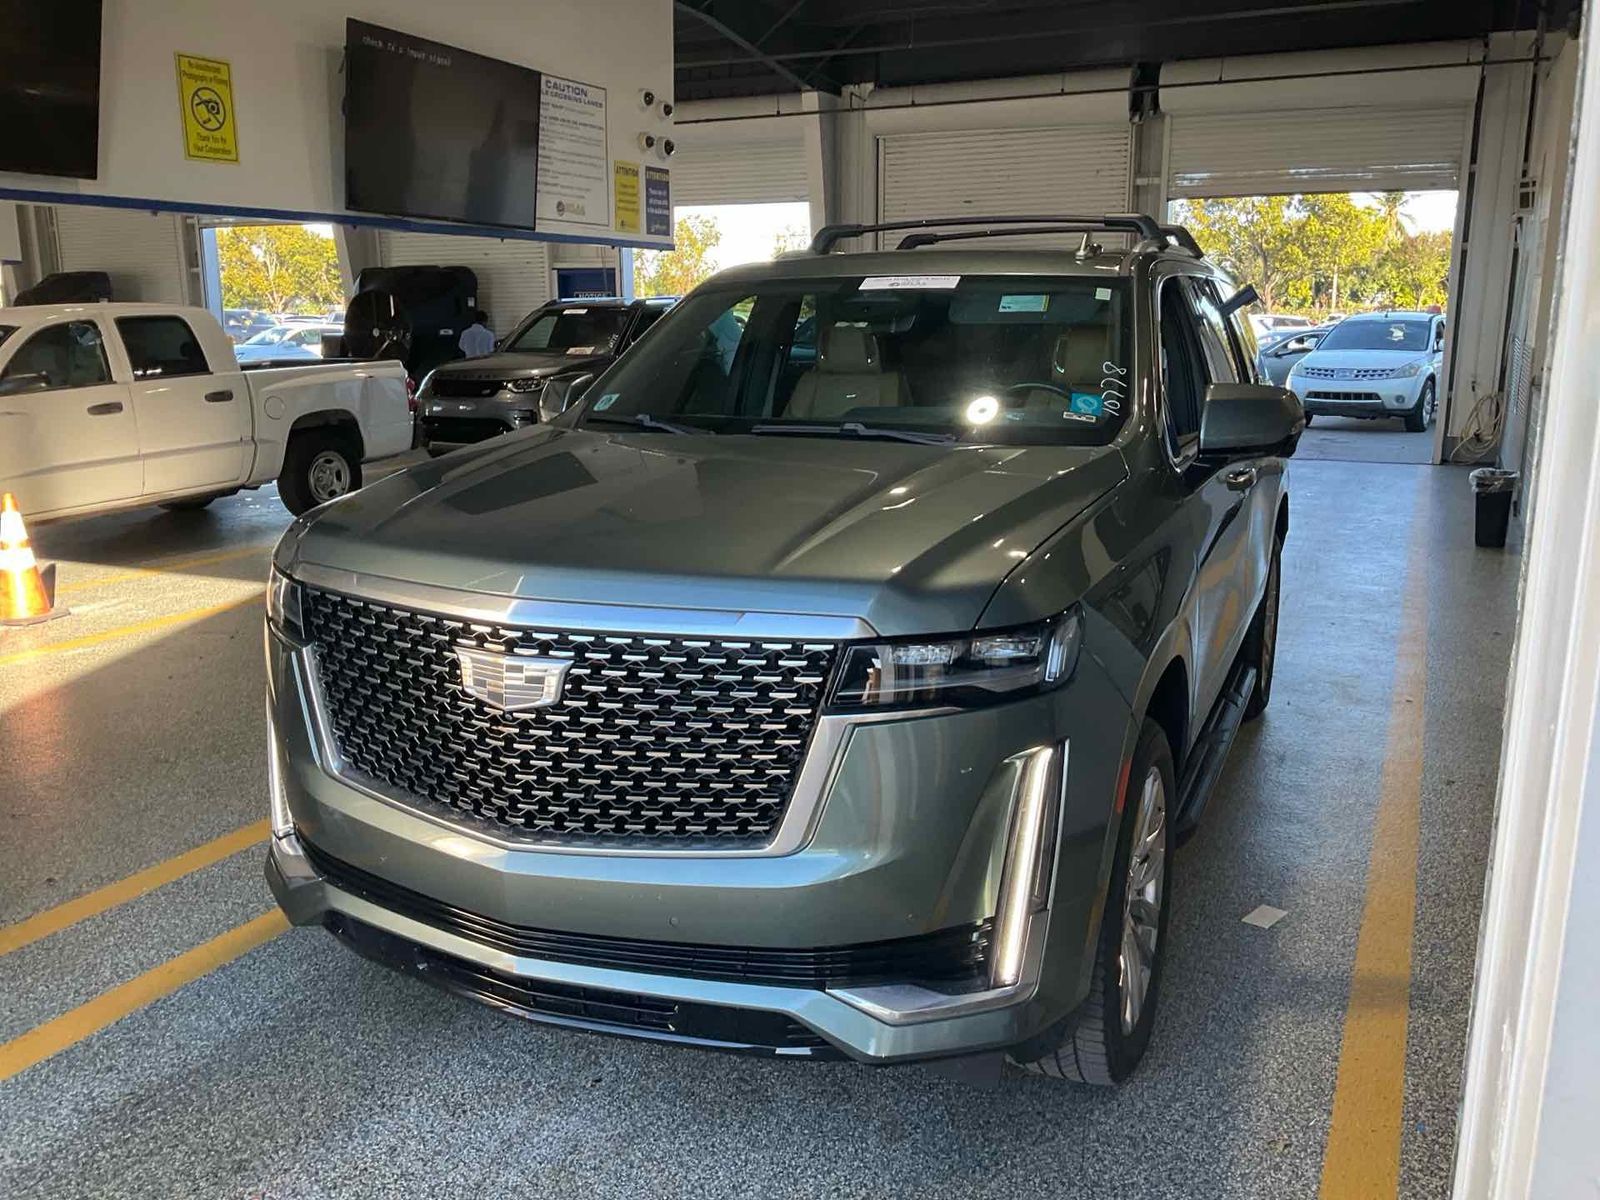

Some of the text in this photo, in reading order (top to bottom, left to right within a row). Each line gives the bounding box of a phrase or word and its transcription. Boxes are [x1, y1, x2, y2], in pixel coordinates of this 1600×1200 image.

[545, 80, 588, 97] CAUTION
[583, 98, 603, 109] LANES
[616, 165, 639, 177] ATTENTION
[1100, 361, 1127, 416] 10778
